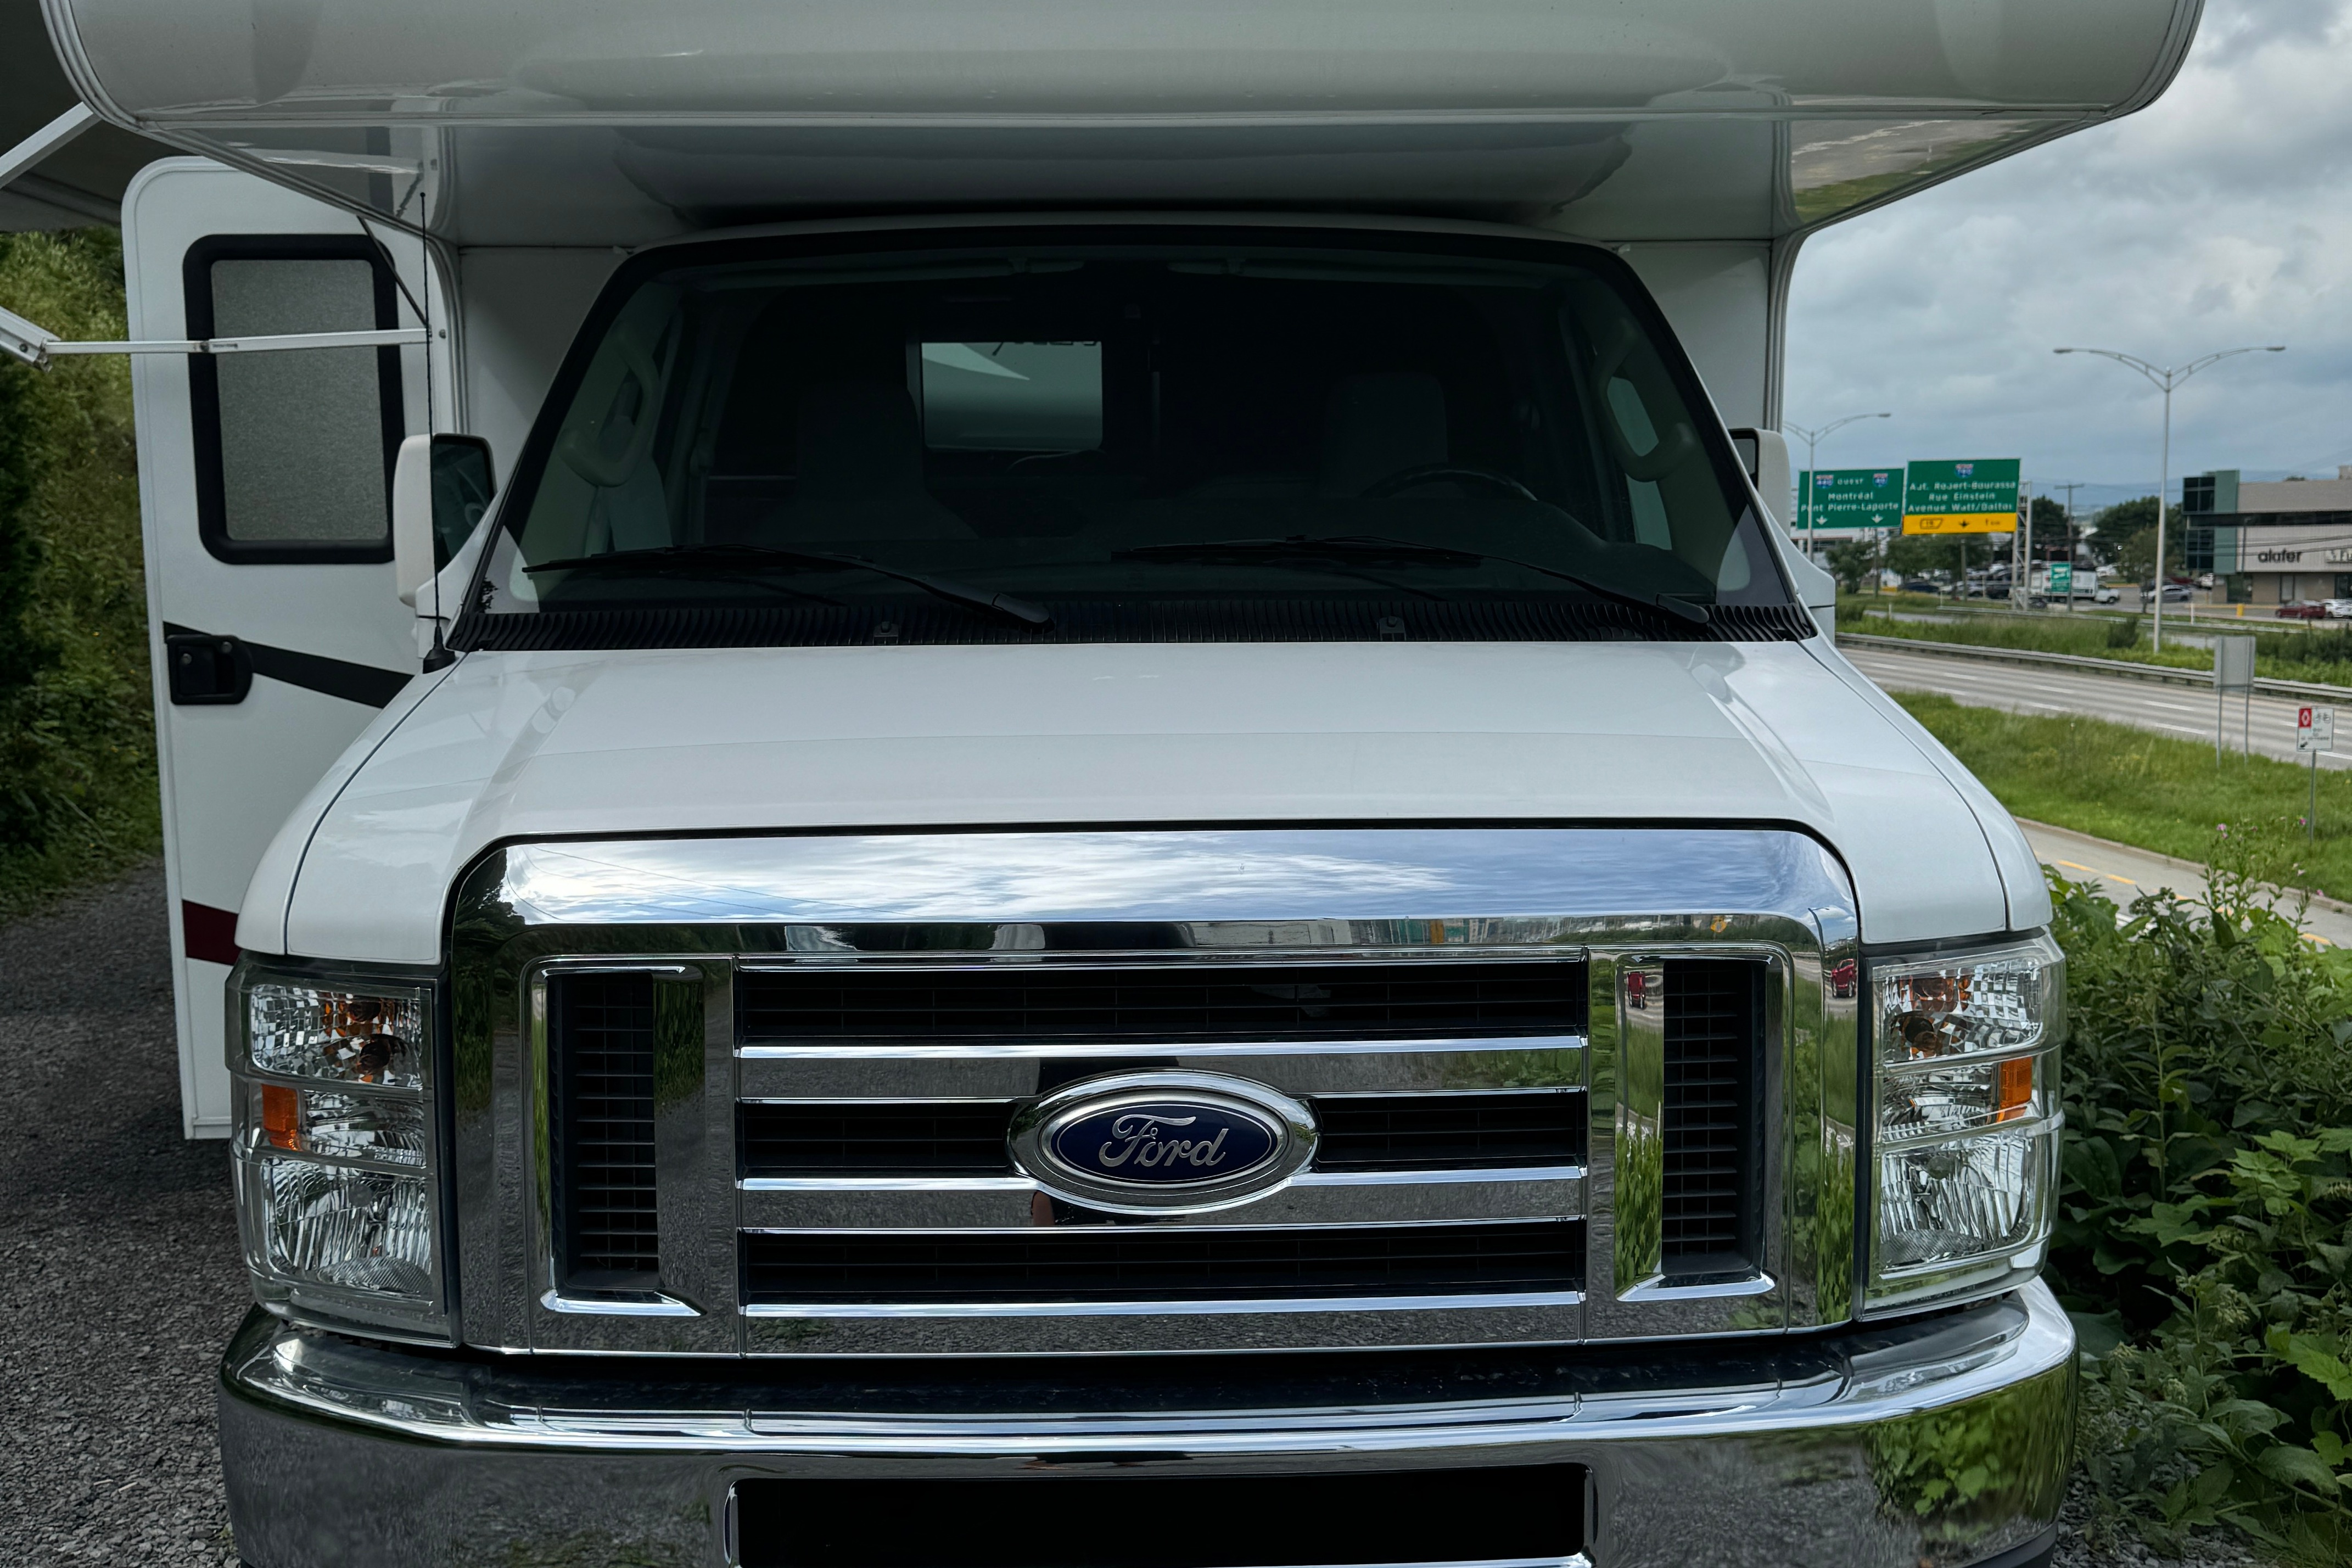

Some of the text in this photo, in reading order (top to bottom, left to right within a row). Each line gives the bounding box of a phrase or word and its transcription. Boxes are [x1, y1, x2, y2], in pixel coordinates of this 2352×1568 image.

[1934, 481, 2017, 490] Robert-Bourassa
[1828, 492, 1873, 501] Montréal
[1929, 491, 1996, 501] Rue Einstein
[1828, 502, 1899, 512] Pierre-Laporte
[1908, 503, 1946, 512] Avenue
[1099, 1114, 1229, 1167] Ford
